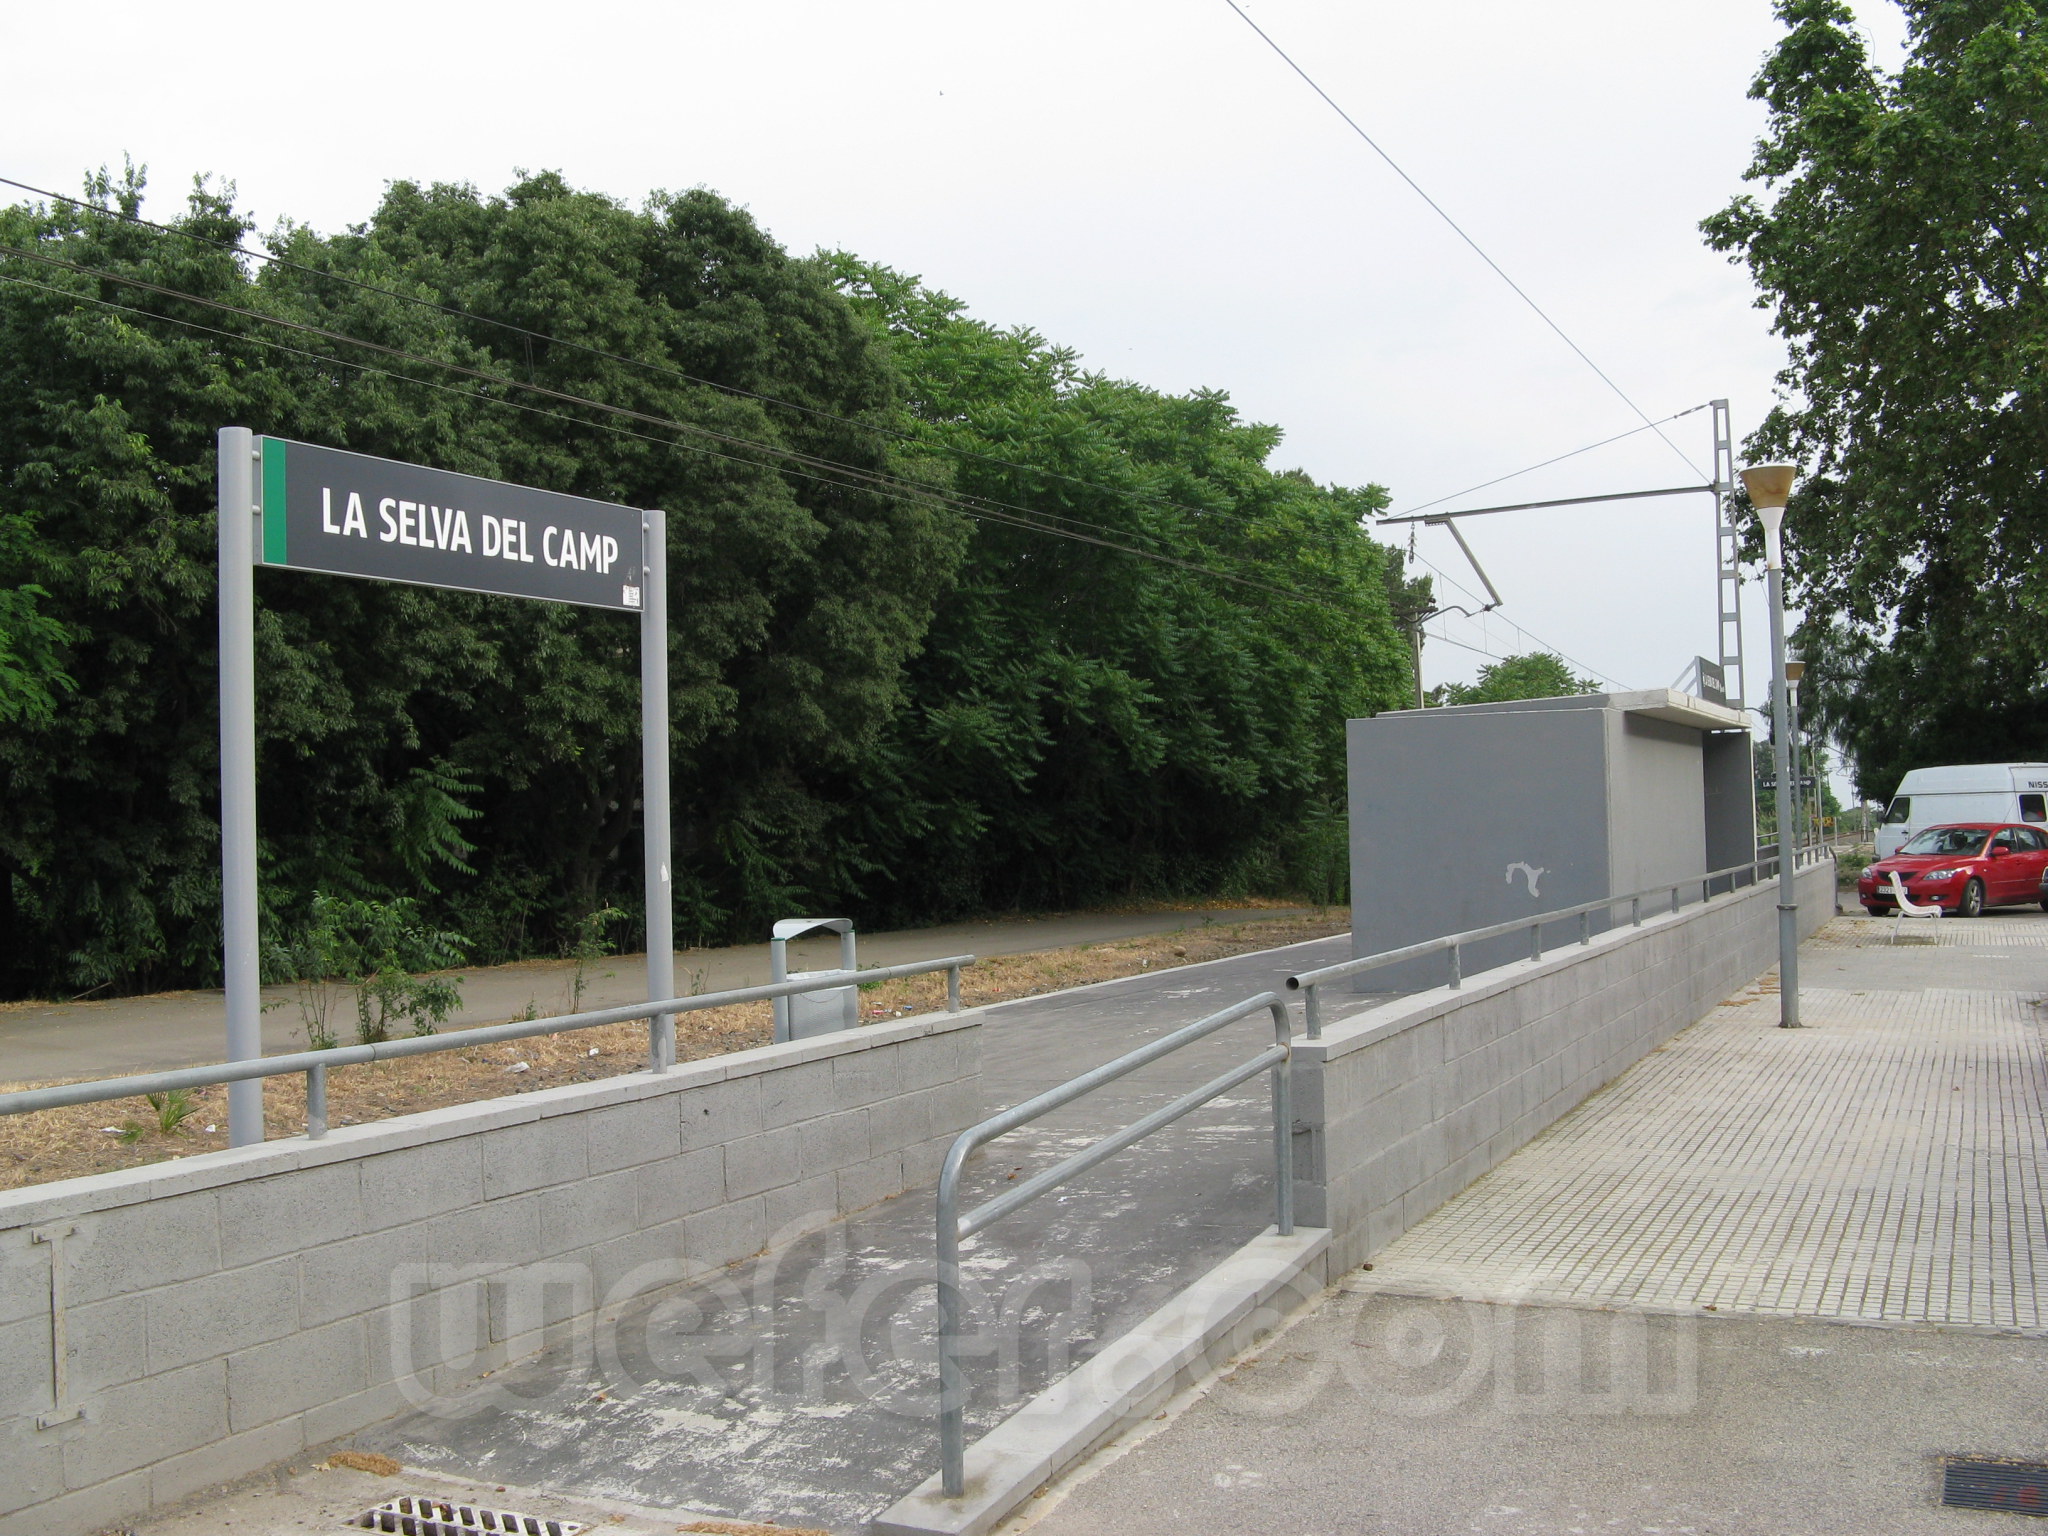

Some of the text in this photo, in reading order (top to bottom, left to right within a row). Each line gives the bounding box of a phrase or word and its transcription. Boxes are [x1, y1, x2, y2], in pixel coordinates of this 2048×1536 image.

[322, 487, 618, 574] LA SELVA DEL CAMP
